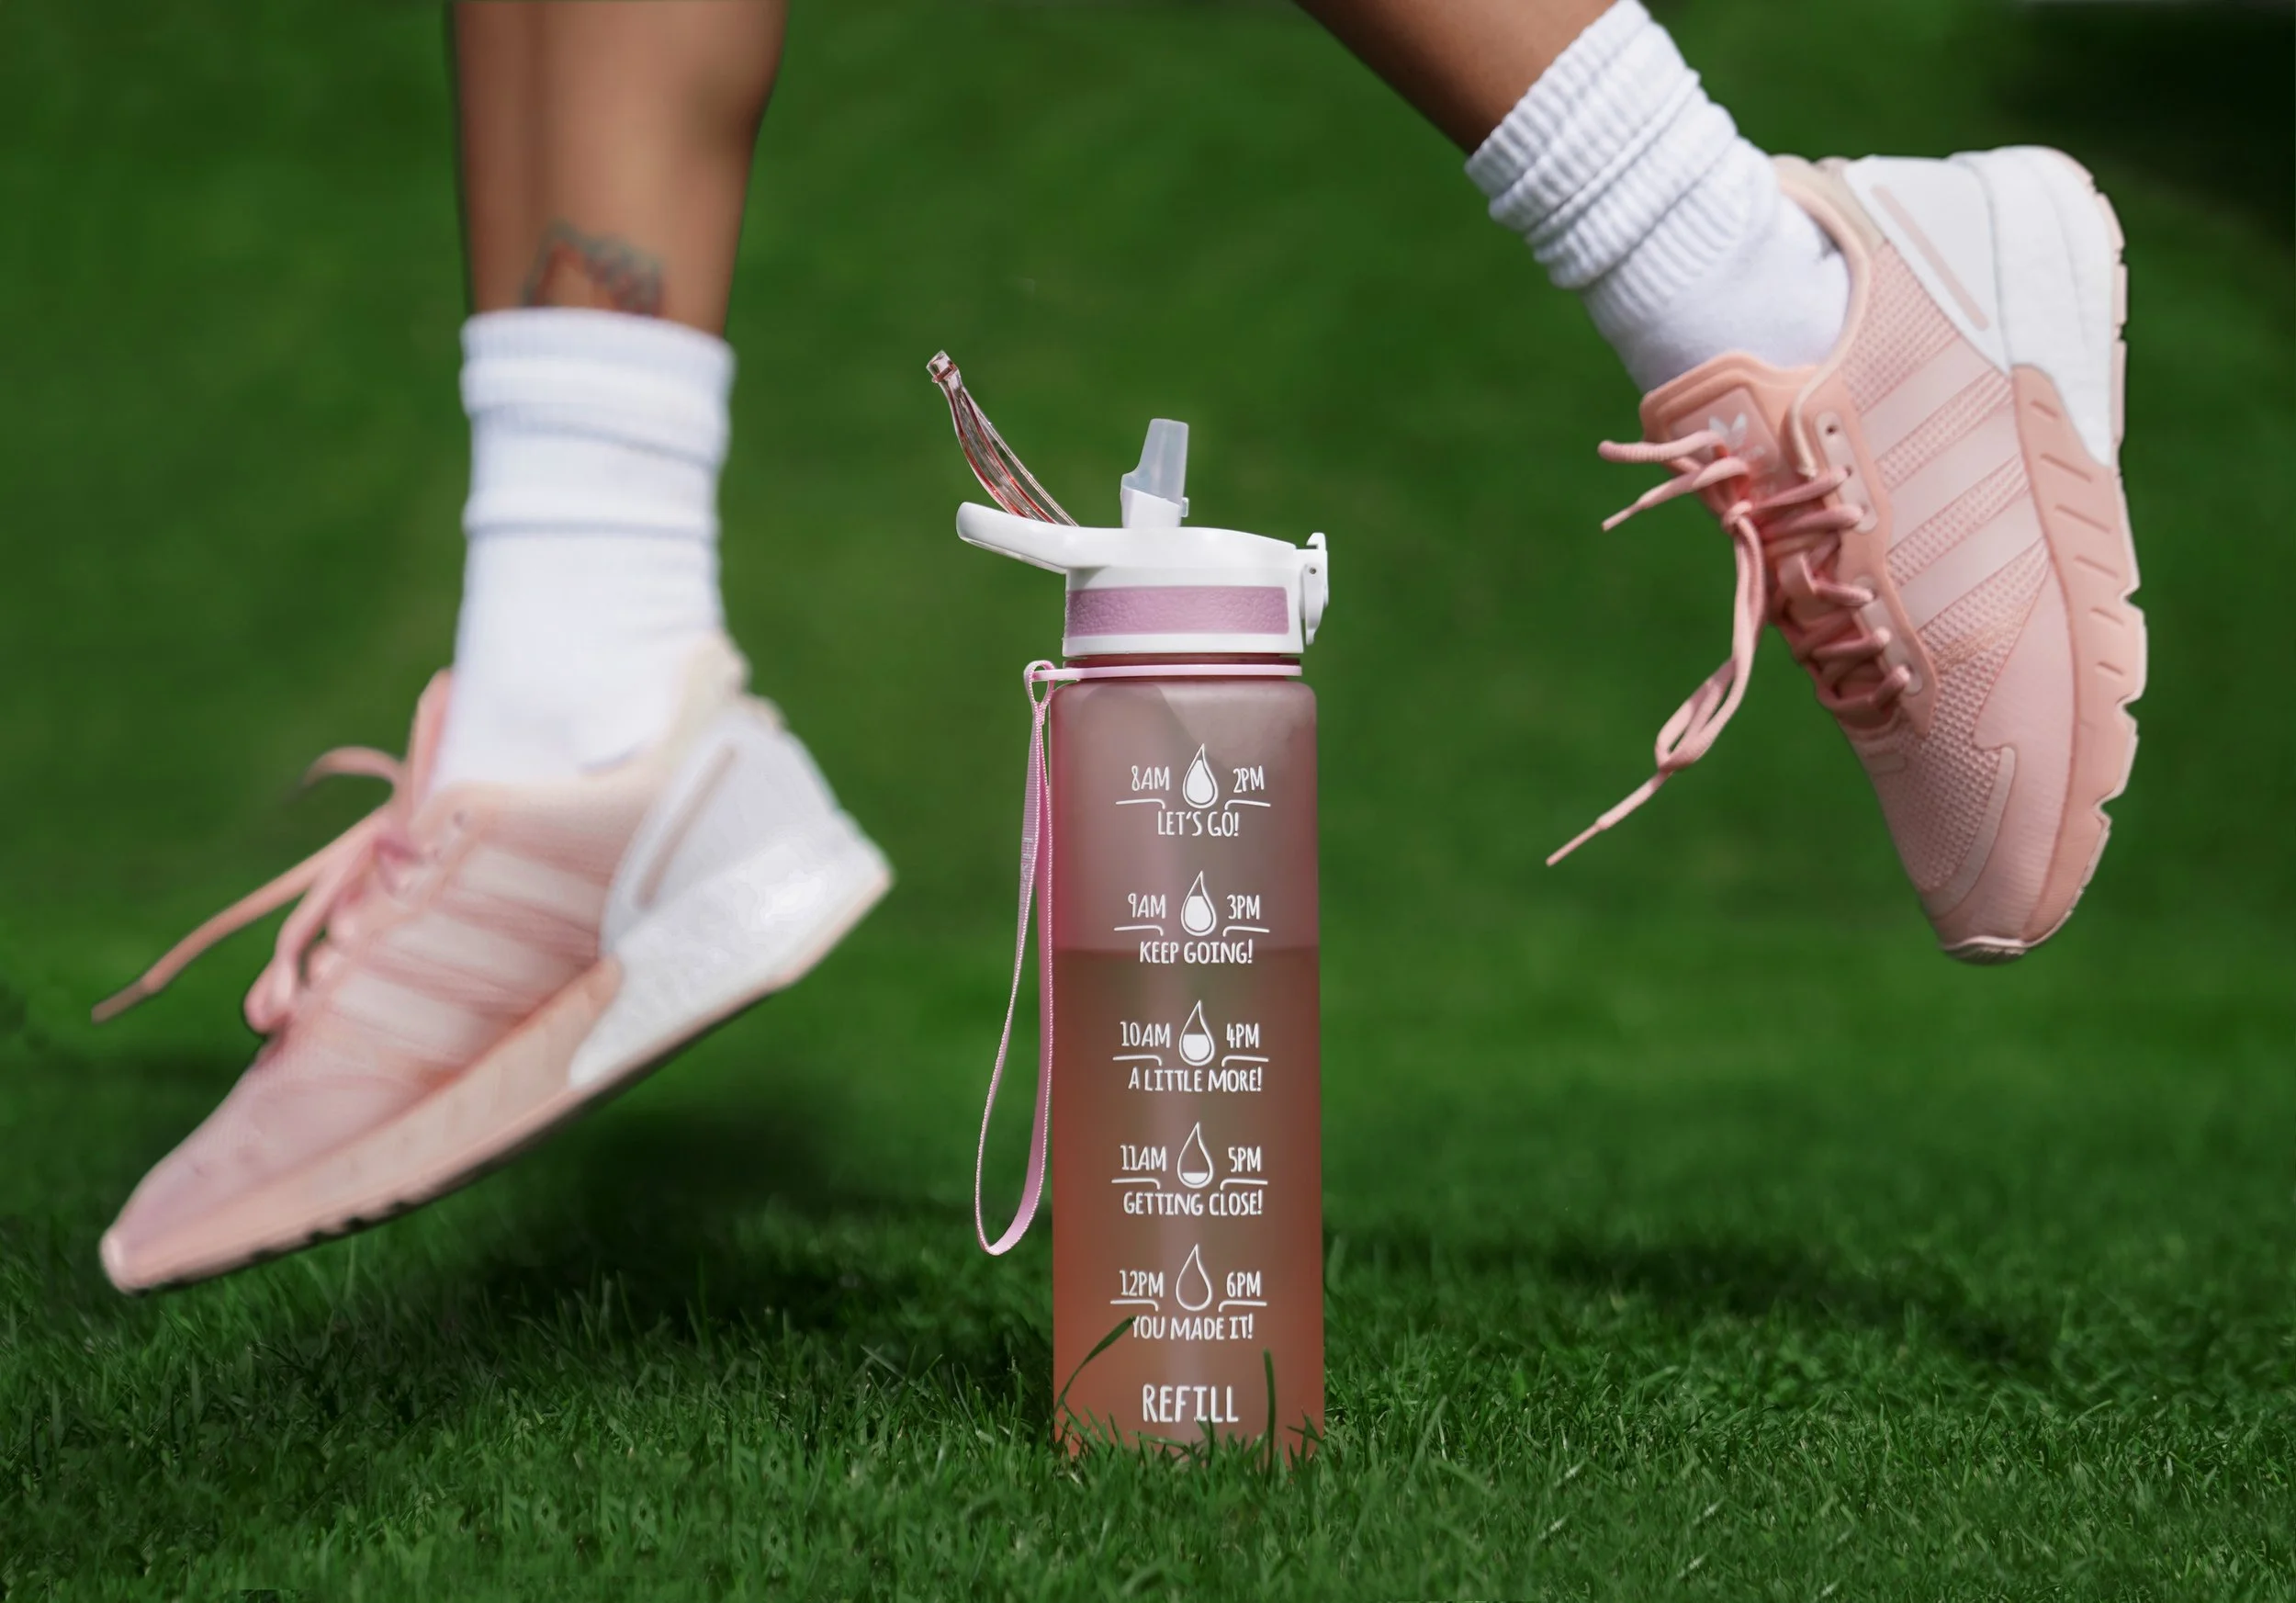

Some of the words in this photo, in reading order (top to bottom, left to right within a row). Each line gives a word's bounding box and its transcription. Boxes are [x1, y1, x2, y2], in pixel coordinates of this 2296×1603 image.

[1131, 765, 1170, 792] 8AM
[1232, 765, 1265, 794] 2PM
[1157, 810, 1203, 837] LET'S
[1207, 811, 1239, 837] GO!
[1127, 893, 1166, 920] 9AM
[1226, 894, 1260, 920] 3PM
[1140, 941, 1179, 964] KEEP
[1183, 938, 1253, 965] GOING!
[1120, 1022, 1171, 1048] 10AM
[1226, 1022, 1259, 1048] 4PM
[1128, 1067, 1140, 1089] A
[1144, 1069, 1203, 1092] LITTLE
[1208, 1067, 1262, 1092] MORE!
[1120, 1145, 1167, 1172] 11AM
[1228, 1146, 1261, 1172] 5PM
[1123, 1191, 1204, 1216] GETTING
[1209, 1189, 1263, 1216] CLOSE!
[1119, 1270, 1164, 1298] 12PM
[1226, 1270, 1261, 1298] 6PM
[1132, 1315, 1165, 1339] YOU
[1170, 1317, 1224, 1341] MADE
[1229, 1313, 1254, 1339] IT!
[1142, 1383, 1239, 1423] REFILL
